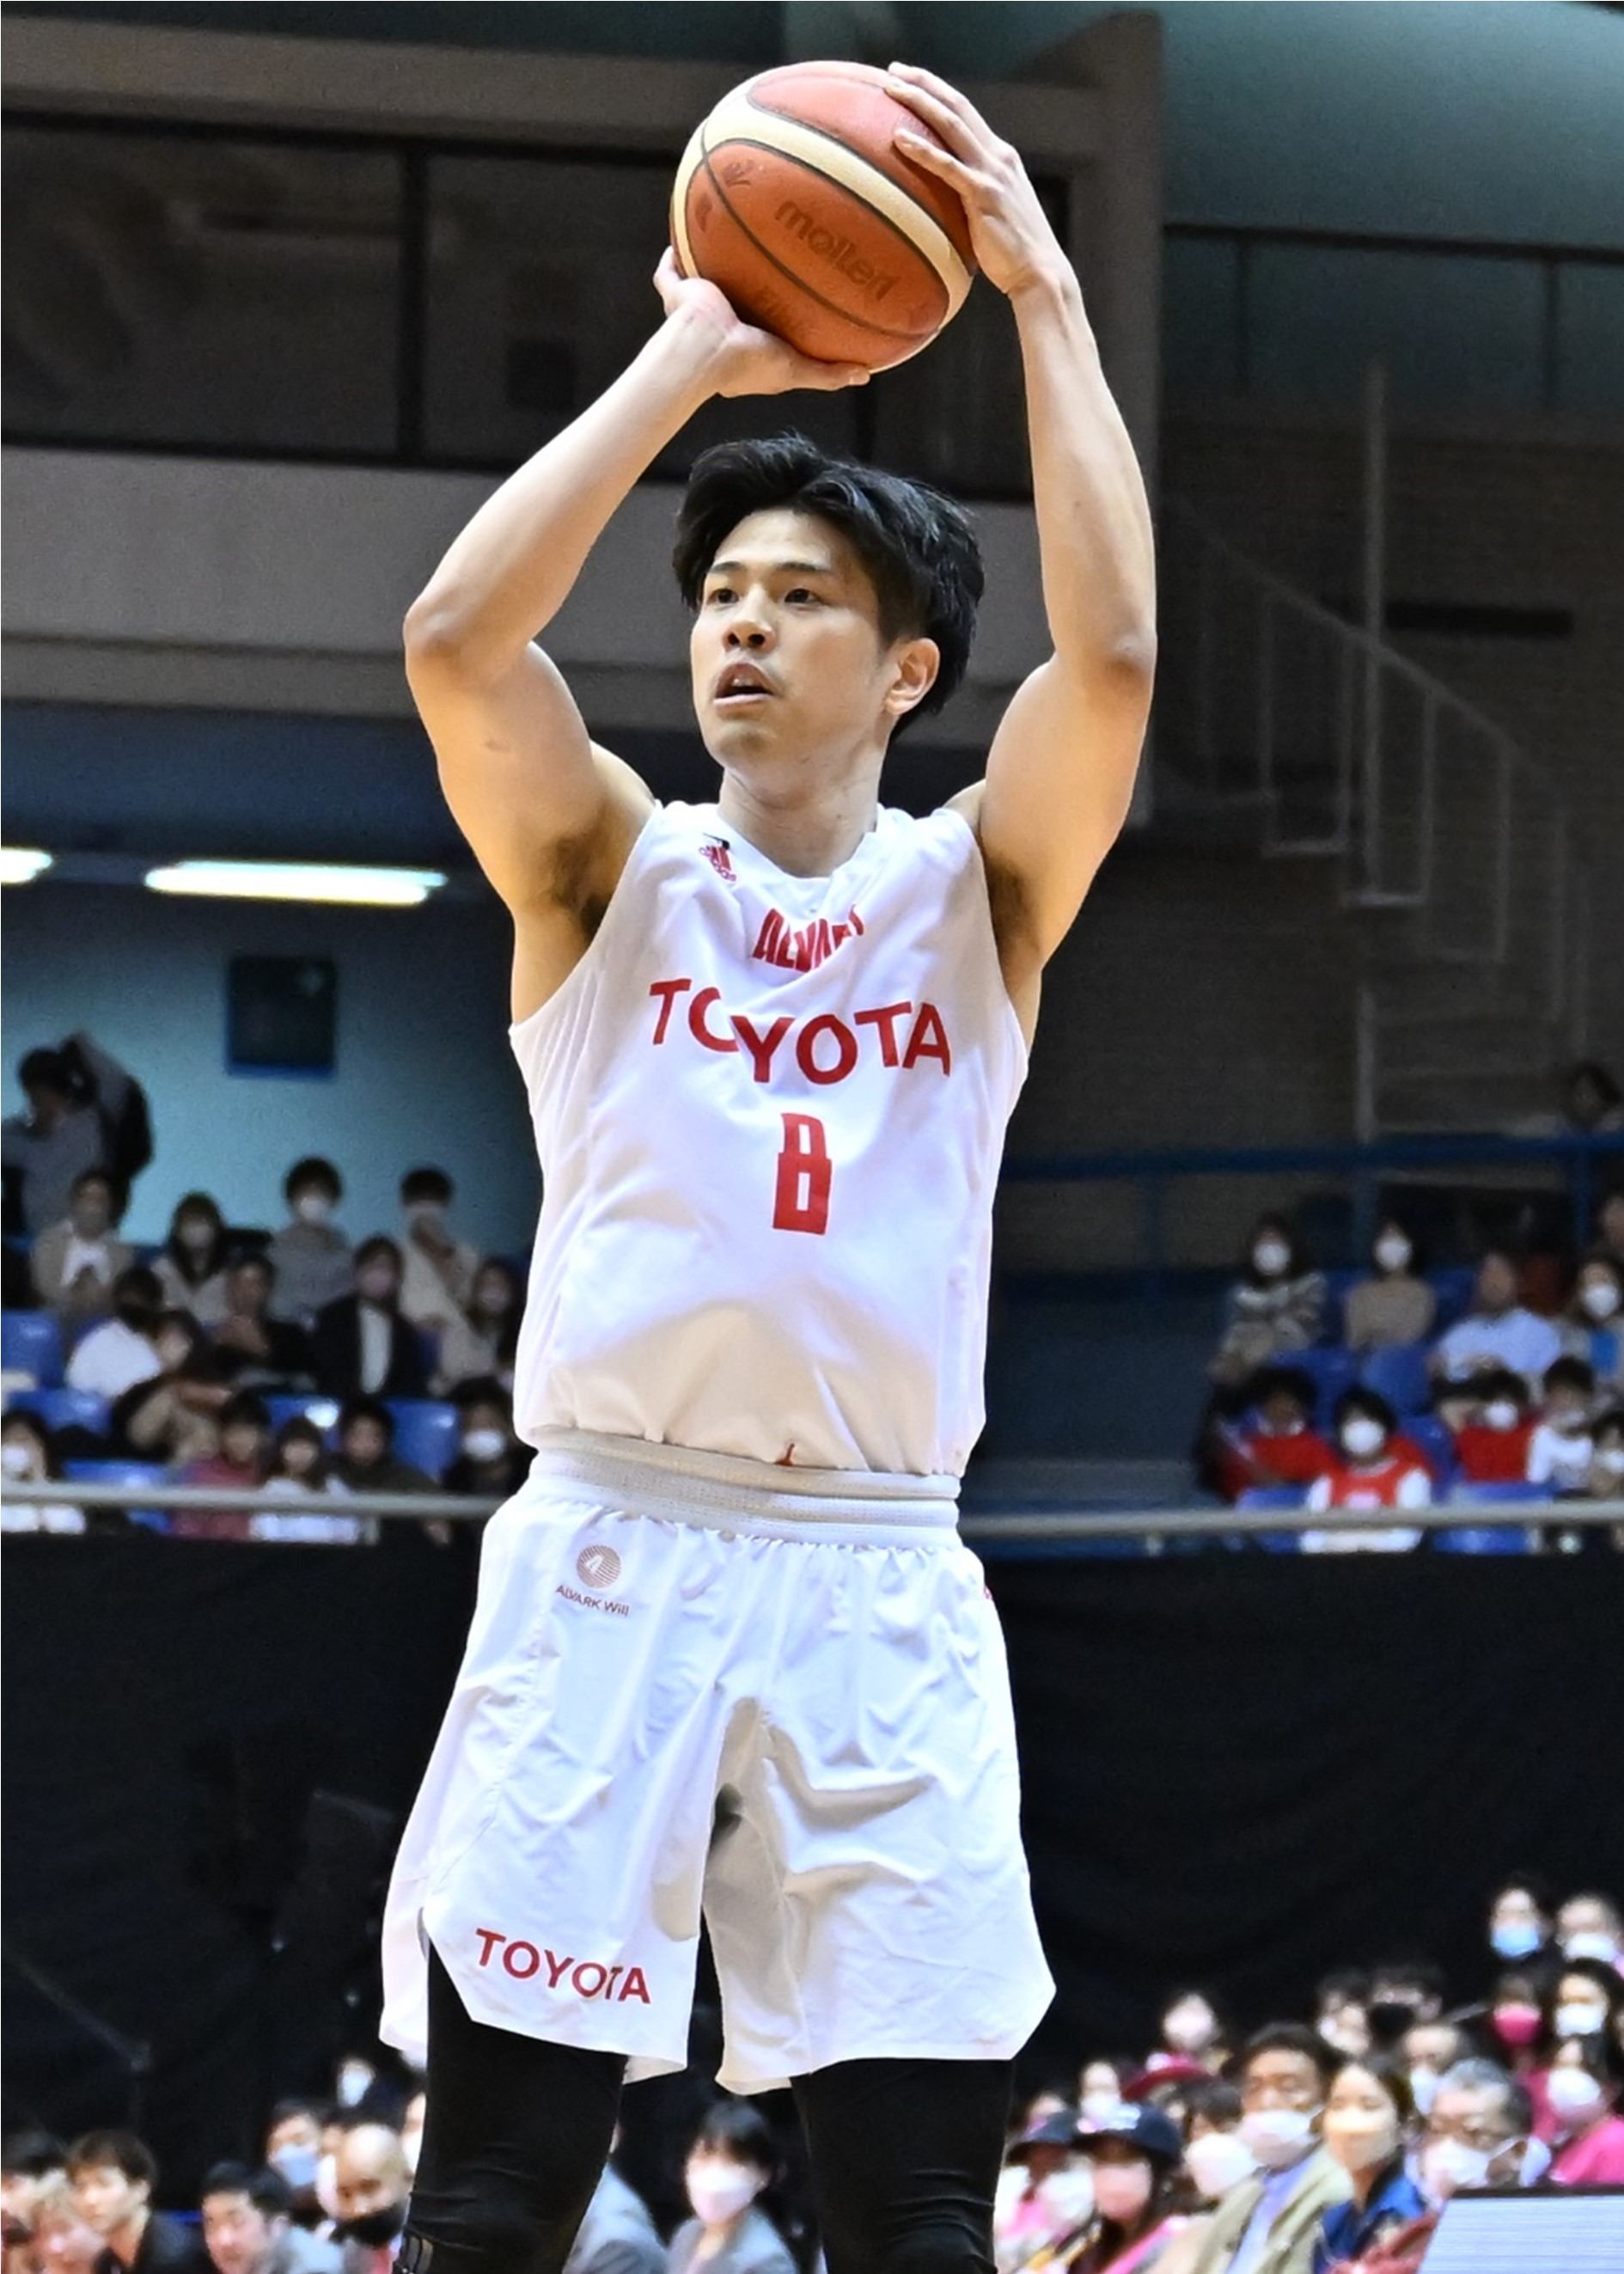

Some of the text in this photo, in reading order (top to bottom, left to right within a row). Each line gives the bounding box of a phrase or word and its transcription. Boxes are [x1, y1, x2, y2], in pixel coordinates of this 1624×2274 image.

[775, 199, 901, 300] molten
[649, 978, 950, 1085] TOYOTA
[772, 1113, 832, 1235] 8
[556, 1585, 630, 1617] ALVARK Will
[475, 1928, 651, 2004] TOYOTA
